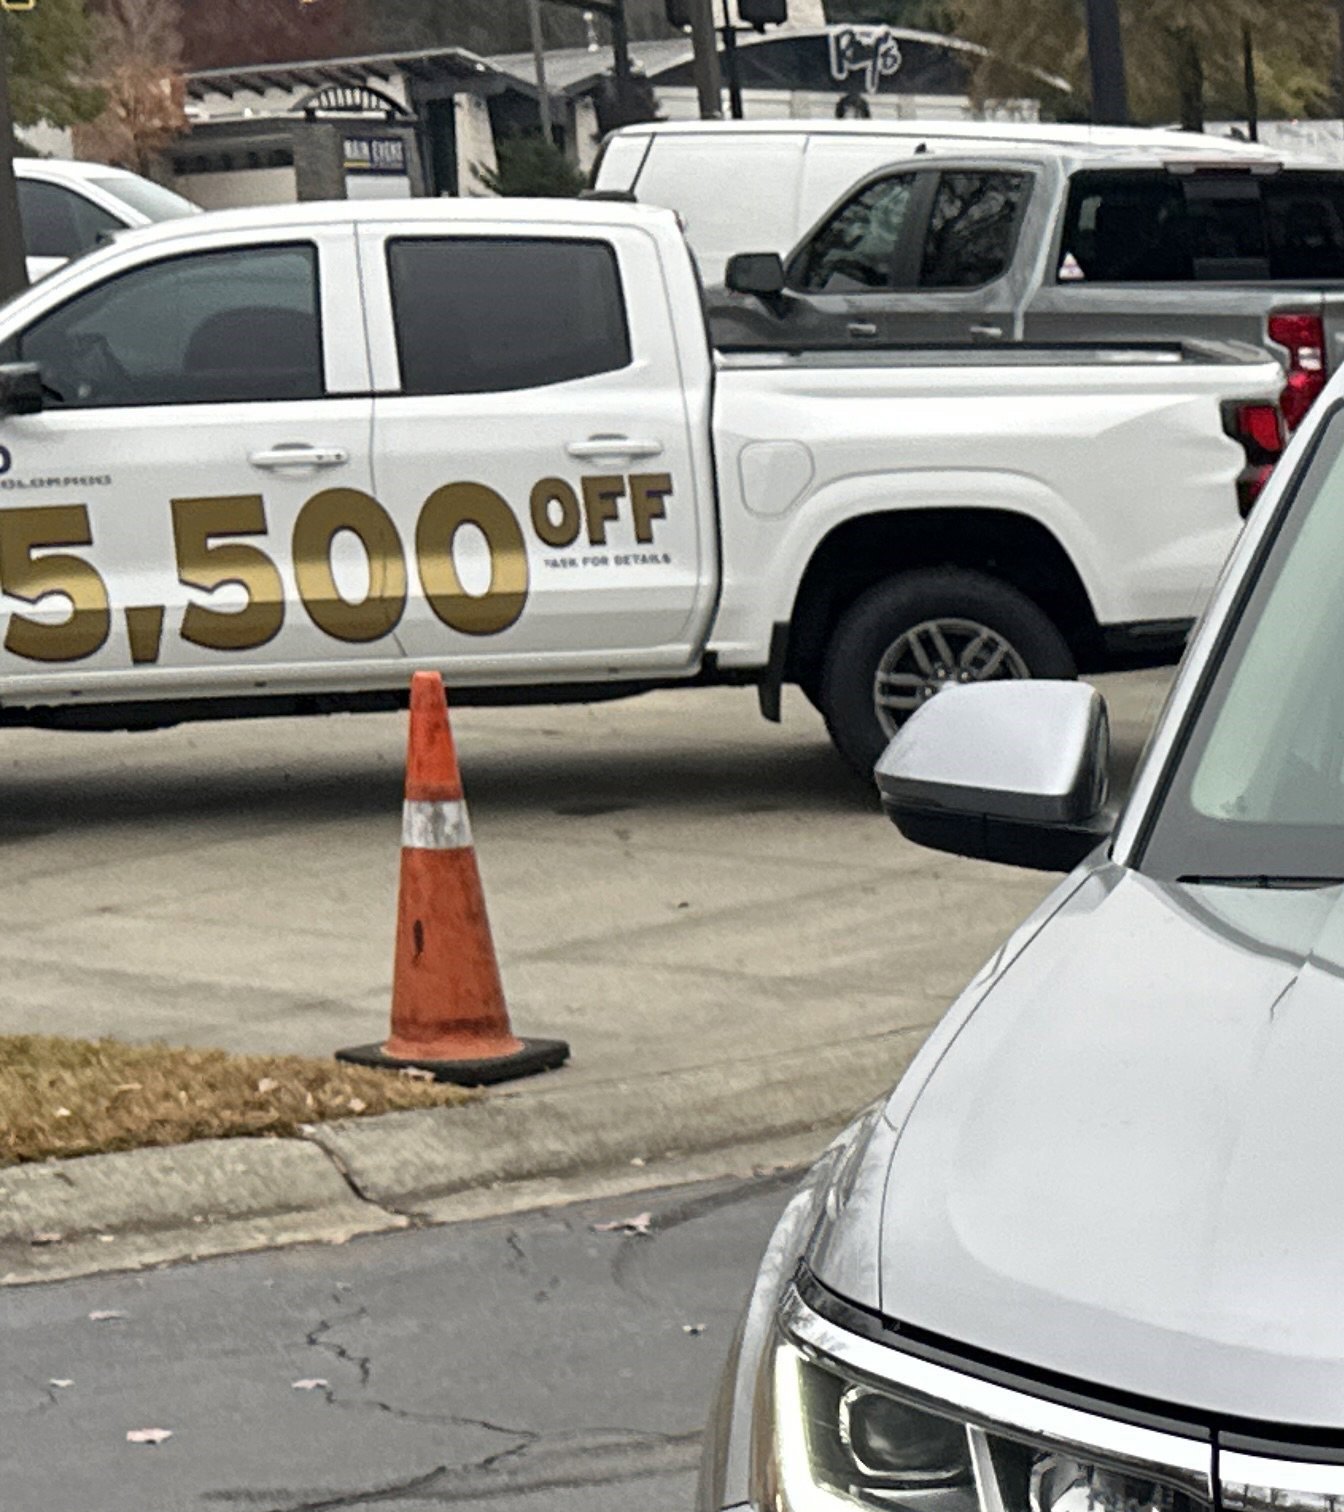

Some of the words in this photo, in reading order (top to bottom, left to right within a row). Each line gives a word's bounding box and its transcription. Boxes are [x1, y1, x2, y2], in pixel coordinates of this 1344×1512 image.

[0, 480, 531, 665] 5,500
[530, 473, 673, 548] OFF
[581, 555, 609, 567] FOR
